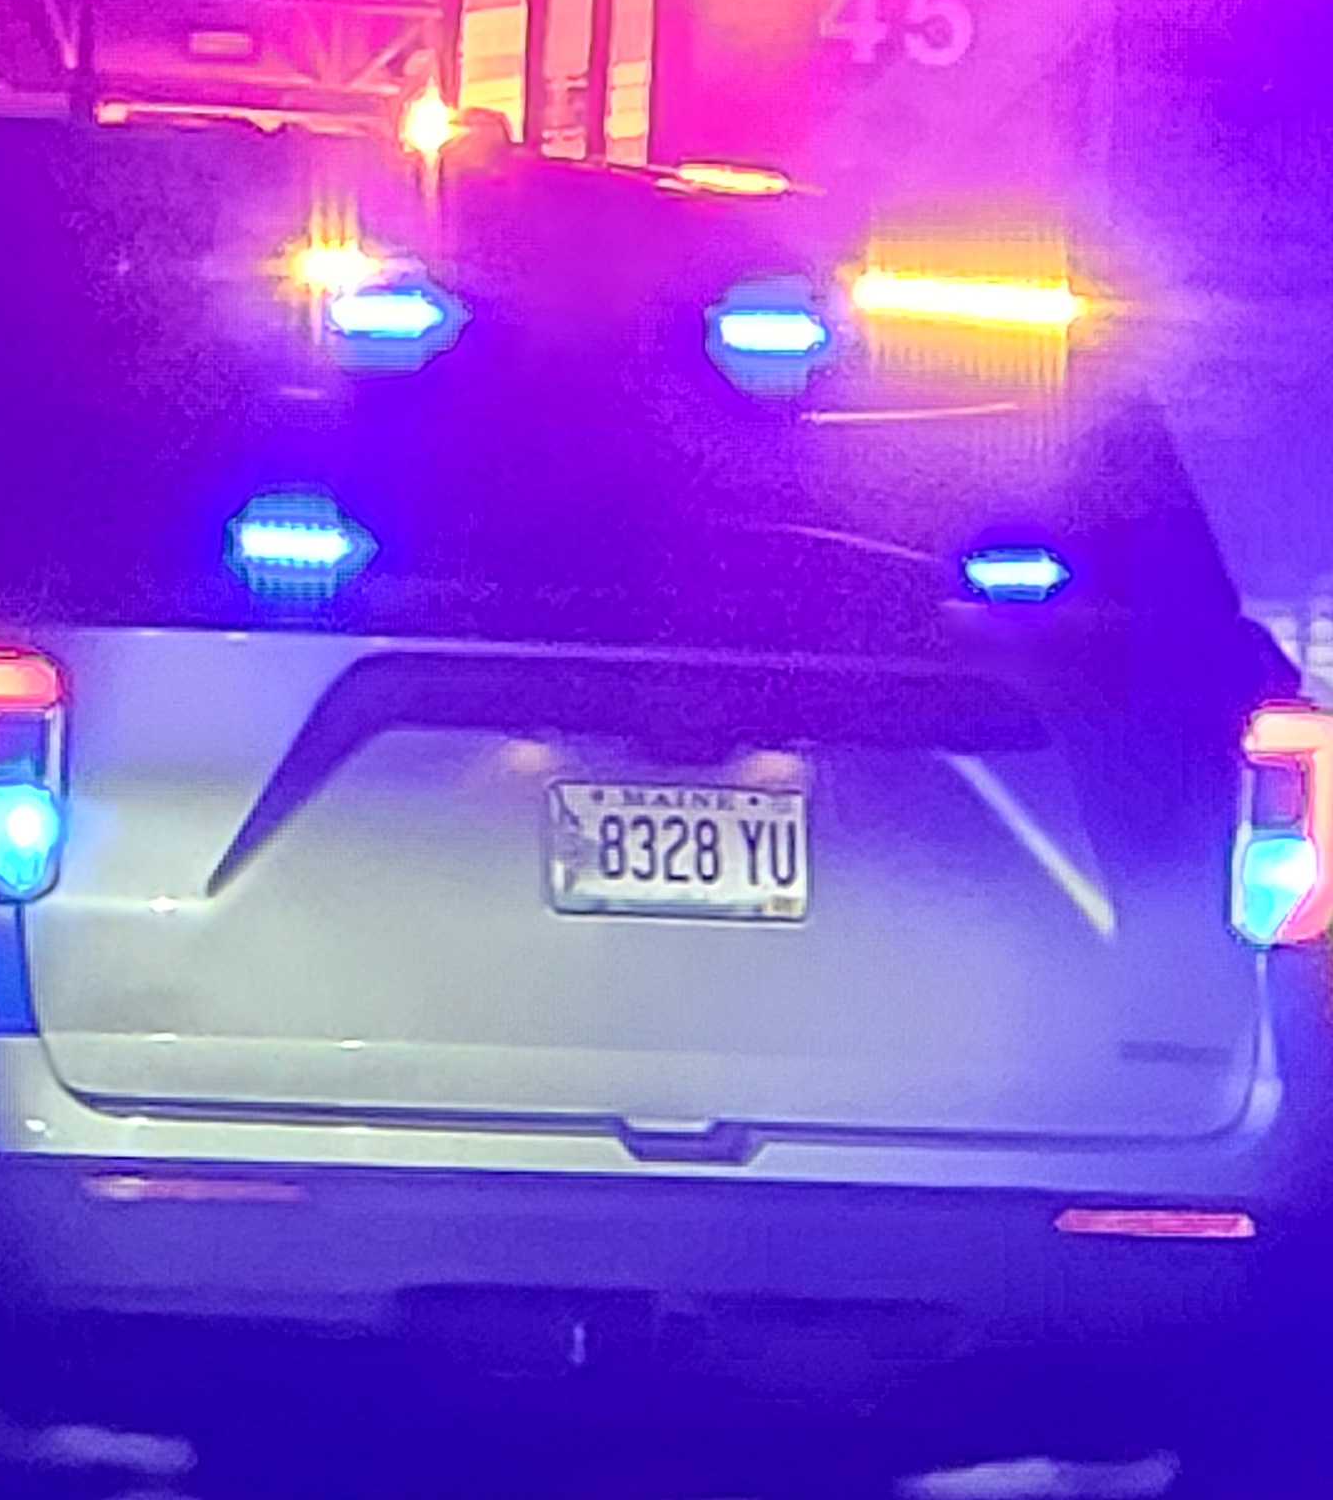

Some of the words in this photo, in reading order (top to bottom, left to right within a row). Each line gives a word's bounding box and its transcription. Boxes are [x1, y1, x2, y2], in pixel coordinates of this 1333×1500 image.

[622, 789, 735, 811] MAINE
[598, 814, 723, 885] 8328
[738, 819, 798, 888] YU
